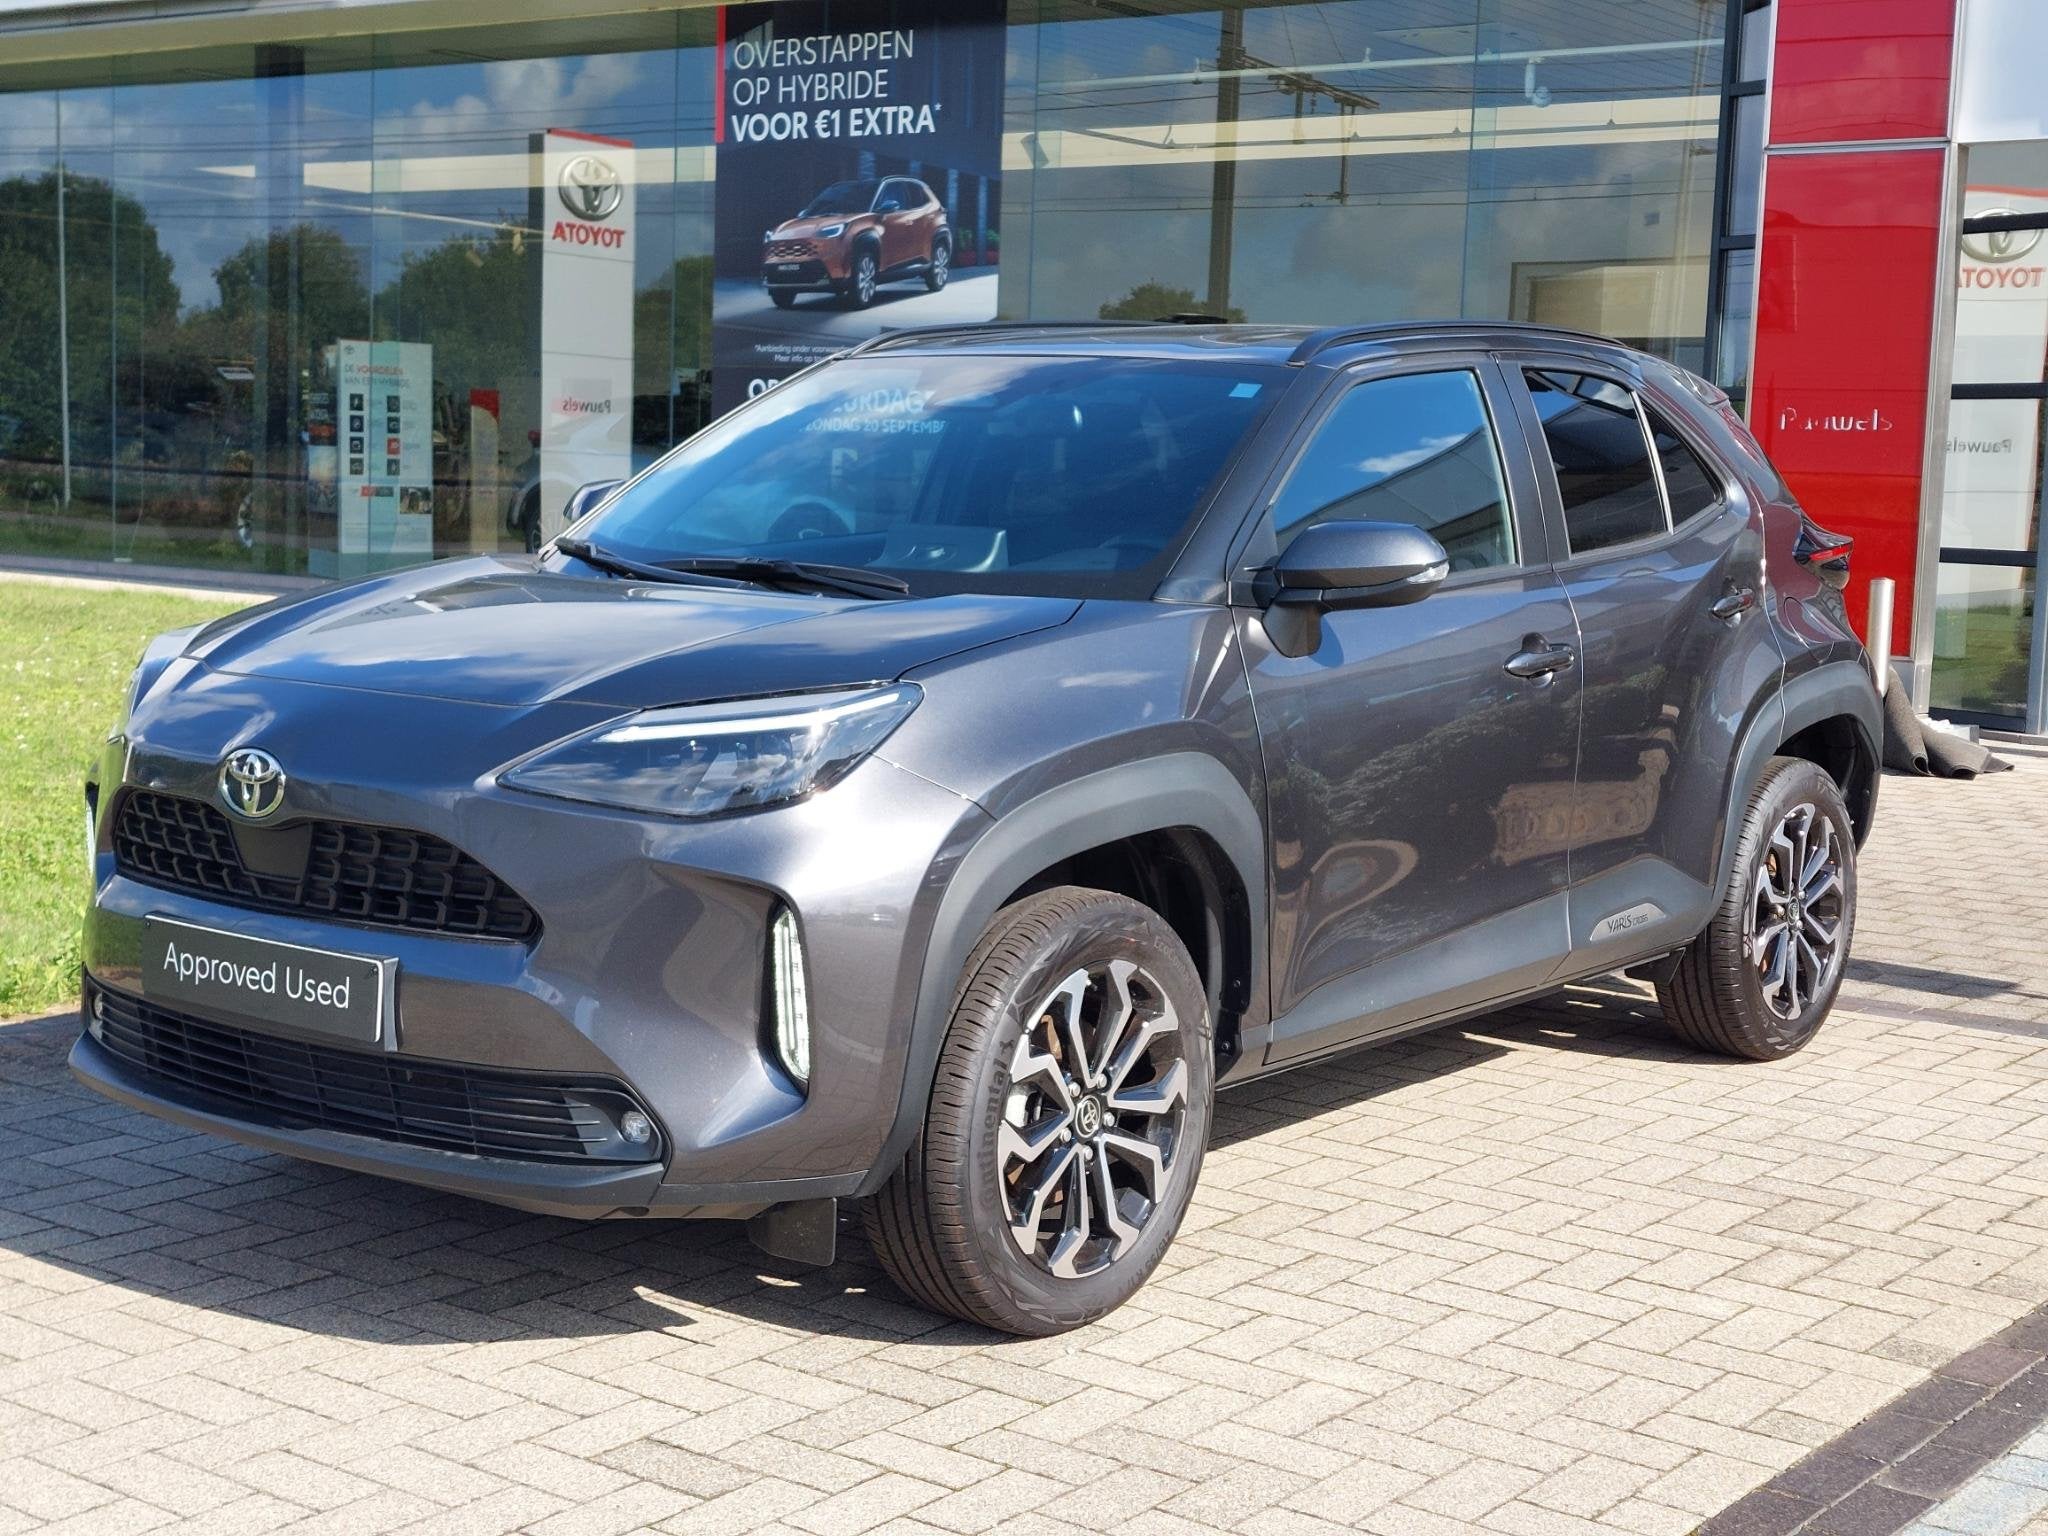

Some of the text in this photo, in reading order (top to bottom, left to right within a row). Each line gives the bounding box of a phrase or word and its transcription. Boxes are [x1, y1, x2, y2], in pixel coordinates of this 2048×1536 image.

[733, 29, 915, 70] OVERSTAPPEN
[732, 68, 889, 107] OP HYBRIDE
[731, 111, 809, 143] VOOR
[814, 109, 842, 139] €1
[163, 941, 350, 1009] Approved Used
